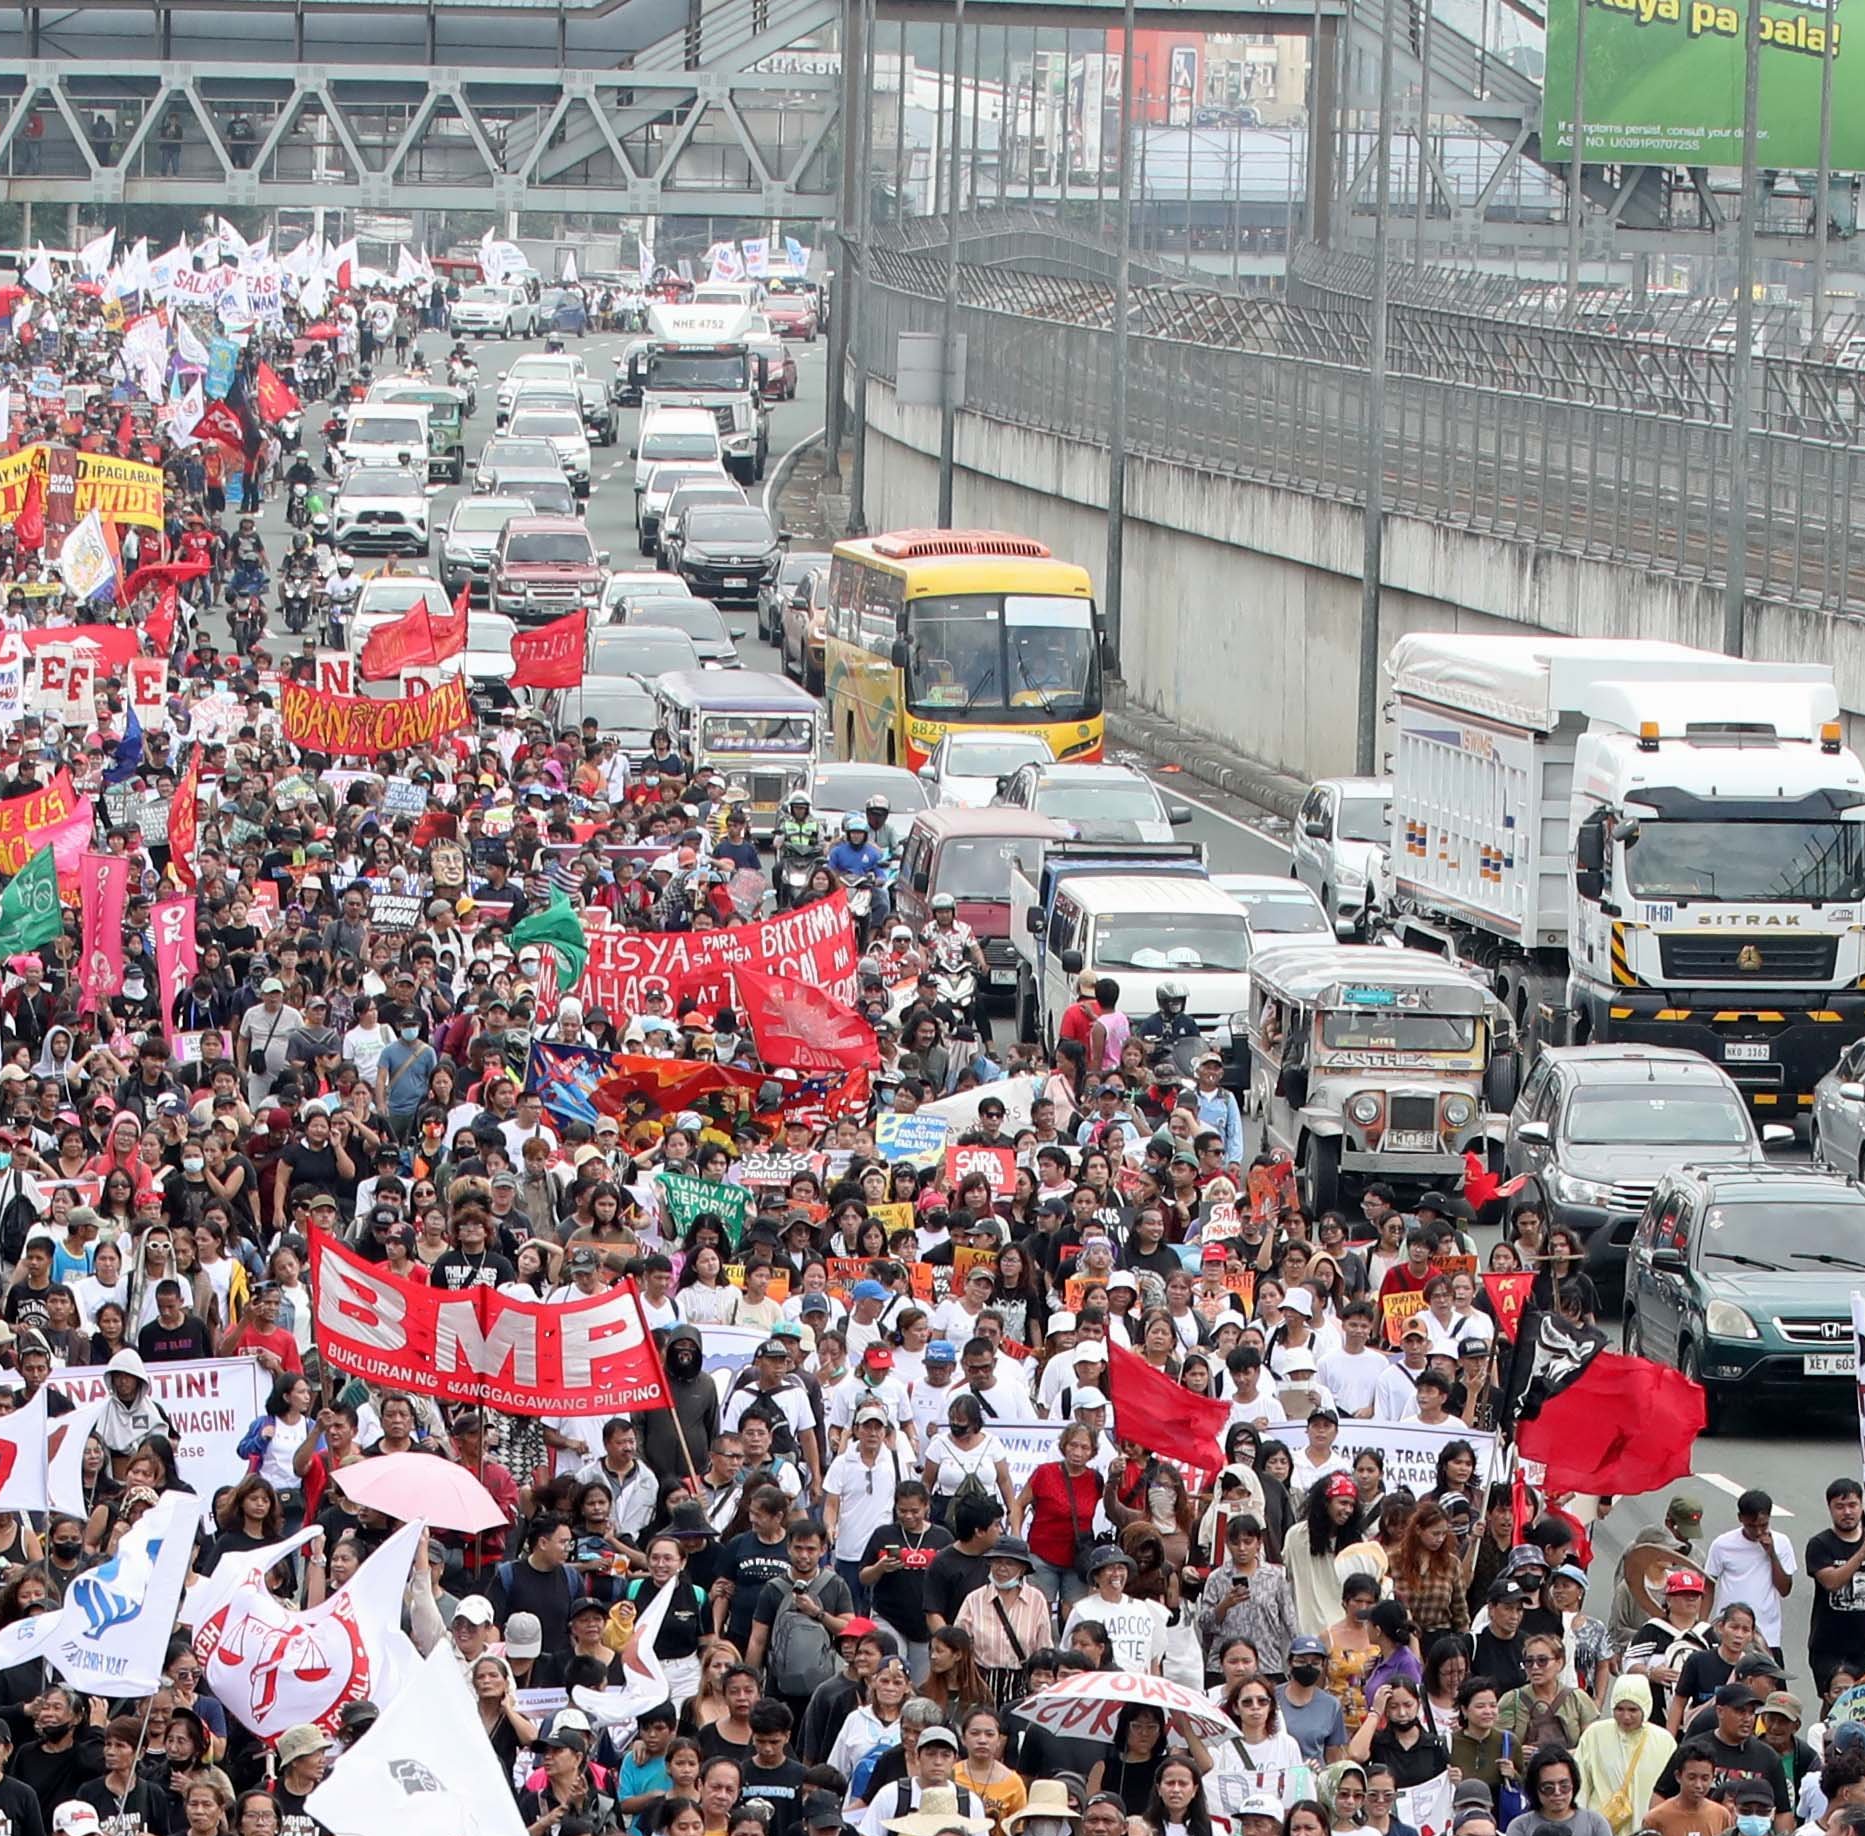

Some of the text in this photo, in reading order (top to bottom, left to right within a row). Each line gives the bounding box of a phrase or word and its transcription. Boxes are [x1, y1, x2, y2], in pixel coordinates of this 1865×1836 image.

[1693, 2, 1738, 34] pa
[1667, 126, 1705, 139] consult
[1708, 129, 1731, 141] your
[1697, 913, 1803, 928] SITRAK
[702, 931, 738, 950] PARA
[722, 946, 752, 965] MGA
[669, 1174, 745, 1203] TUNAY NA
[671, 1188, 739, 1218] REPORMA
[316, 1243, 645, 1390] BMP
[326, 1342, 662, 1411] BUKLURAN NG MANGGAGAWANG PILIPINO
[1808, 1358, 1831, 1369] XEY
